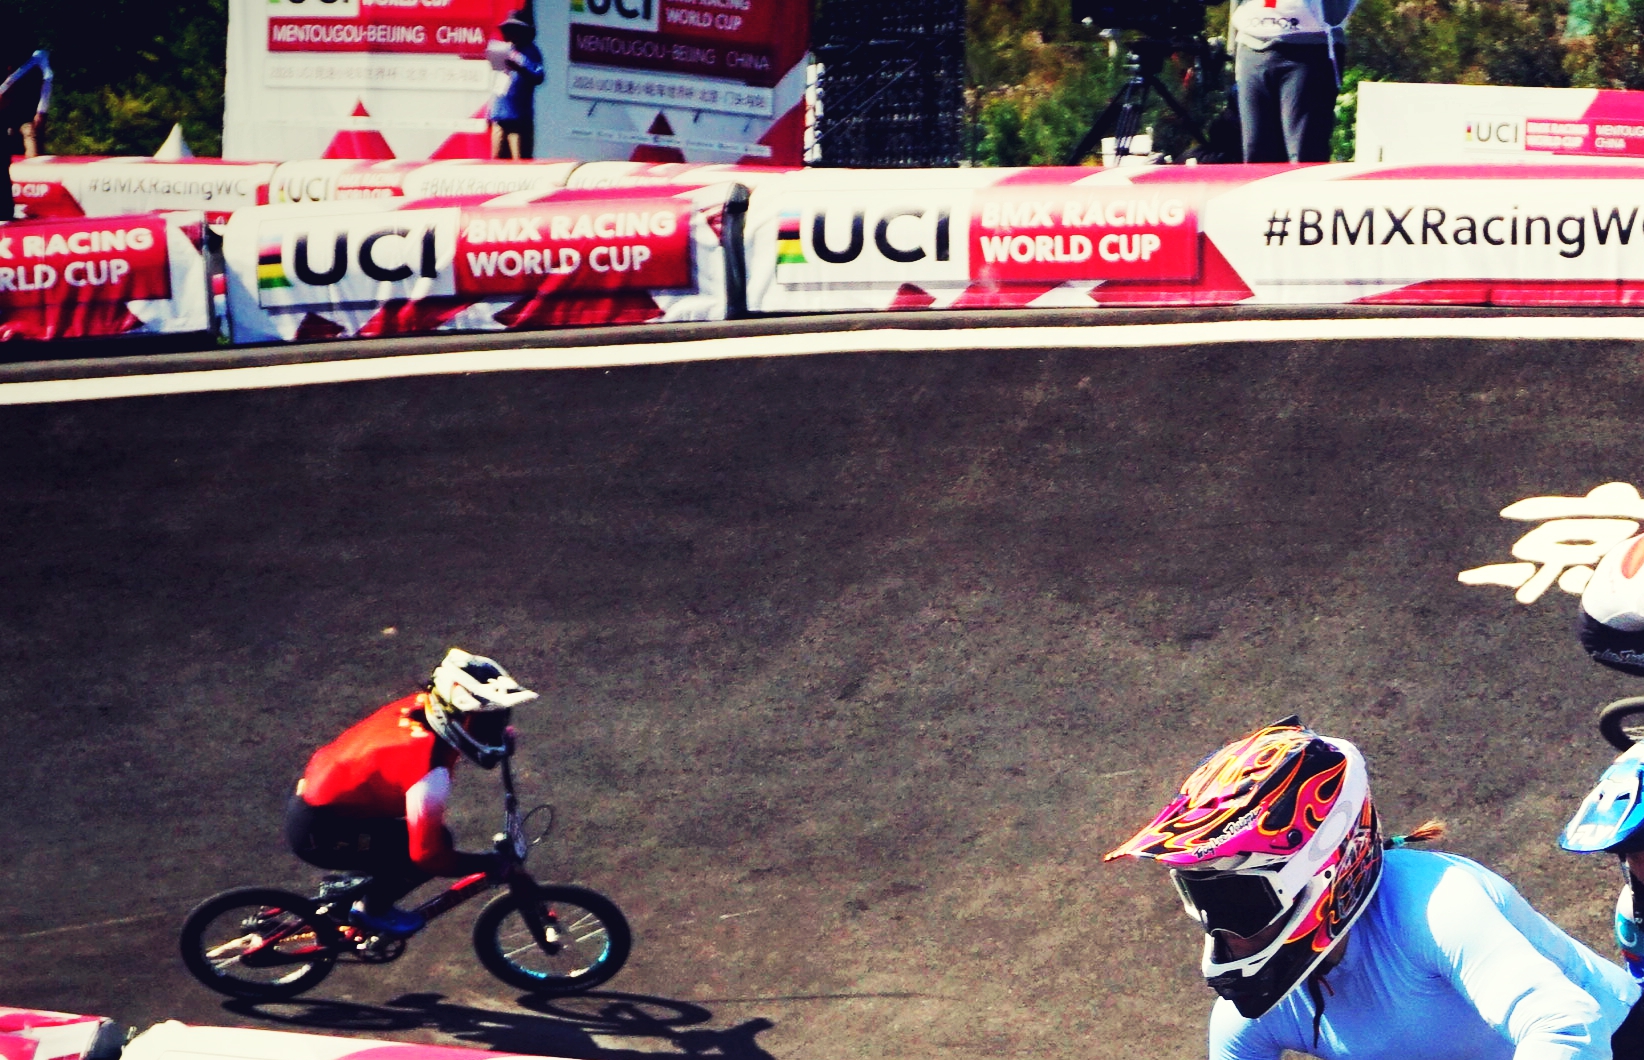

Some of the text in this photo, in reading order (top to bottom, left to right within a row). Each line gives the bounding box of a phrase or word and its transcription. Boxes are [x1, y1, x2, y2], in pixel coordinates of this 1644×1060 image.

[665, 7, 742, 31] WORLD CUP
[273, 24, 484, 45] MENTOUGOU-BEIJING CHINA
[575, 34, 770, 71] MENTOUGOU-BEIJING CHINA
[1476, 122, 1518, 143] UCI
[1595, 138, 1626, 149] CHINA
[23, 184, 48, 196] CUP
[88, 177, 249, 200] #BMXRacingWC
[288, 177, 329, 202] UCI
[465, 210, 675, 243] BMX RACING
[980, 198, 1186, 228] BMX RACING
[22, 228, 154, 258] RACING
[811, 206, 950, 264] UCI
[980, 234, 1161, 263] WORLD CUP
[294, 222, 438, 286] UCI
[466, 244, 651, 278] WORLD CUP
[64, 258, 129, 287] CUP
